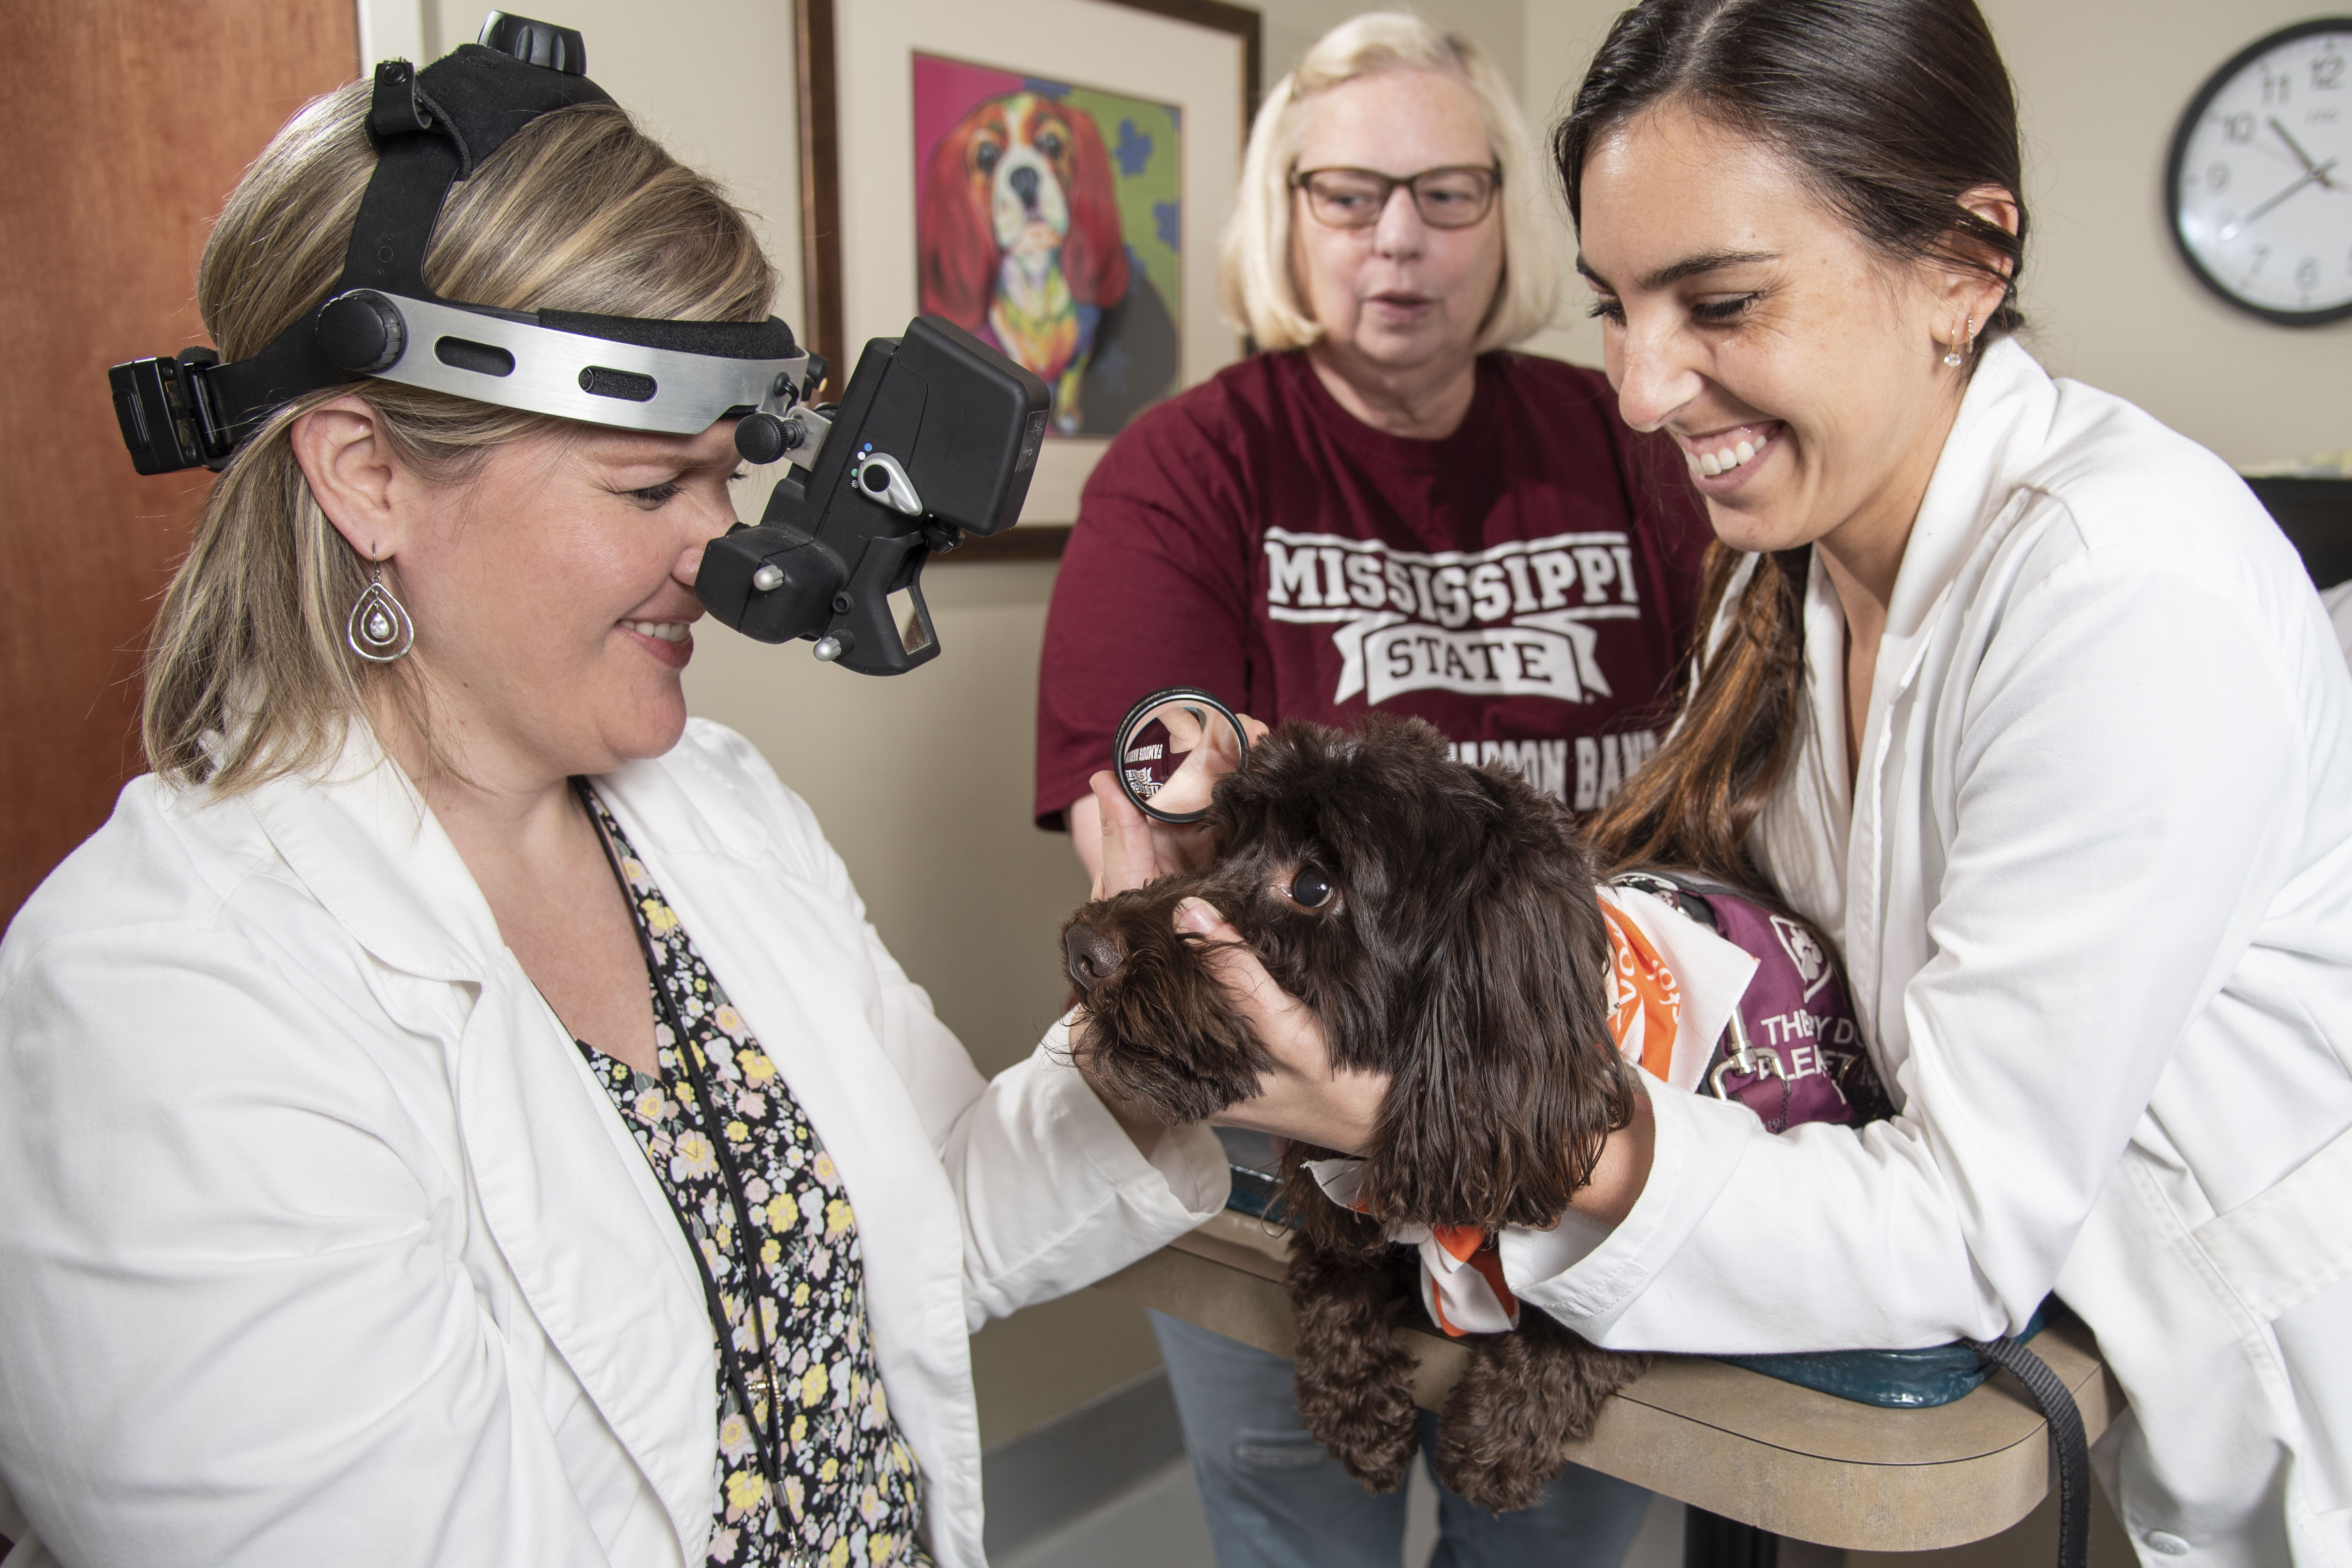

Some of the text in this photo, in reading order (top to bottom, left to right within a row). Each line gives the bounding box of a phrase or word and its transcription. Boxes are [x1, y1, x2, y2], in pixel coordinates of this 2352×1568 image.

[2262, 72, 2291, 106] 11
[2311, 56, 2344, 90] 12
[2223, 110, 2256, 145] 10
[2206, 160, 2231, 196] 9
[2252, 243, 2272, 281] 7
[2294, 255, 2321, 291] 6
[1264, 541, 1639, 628] MISSISSIPPI
[1387, 636, 1552, 683] STATE
